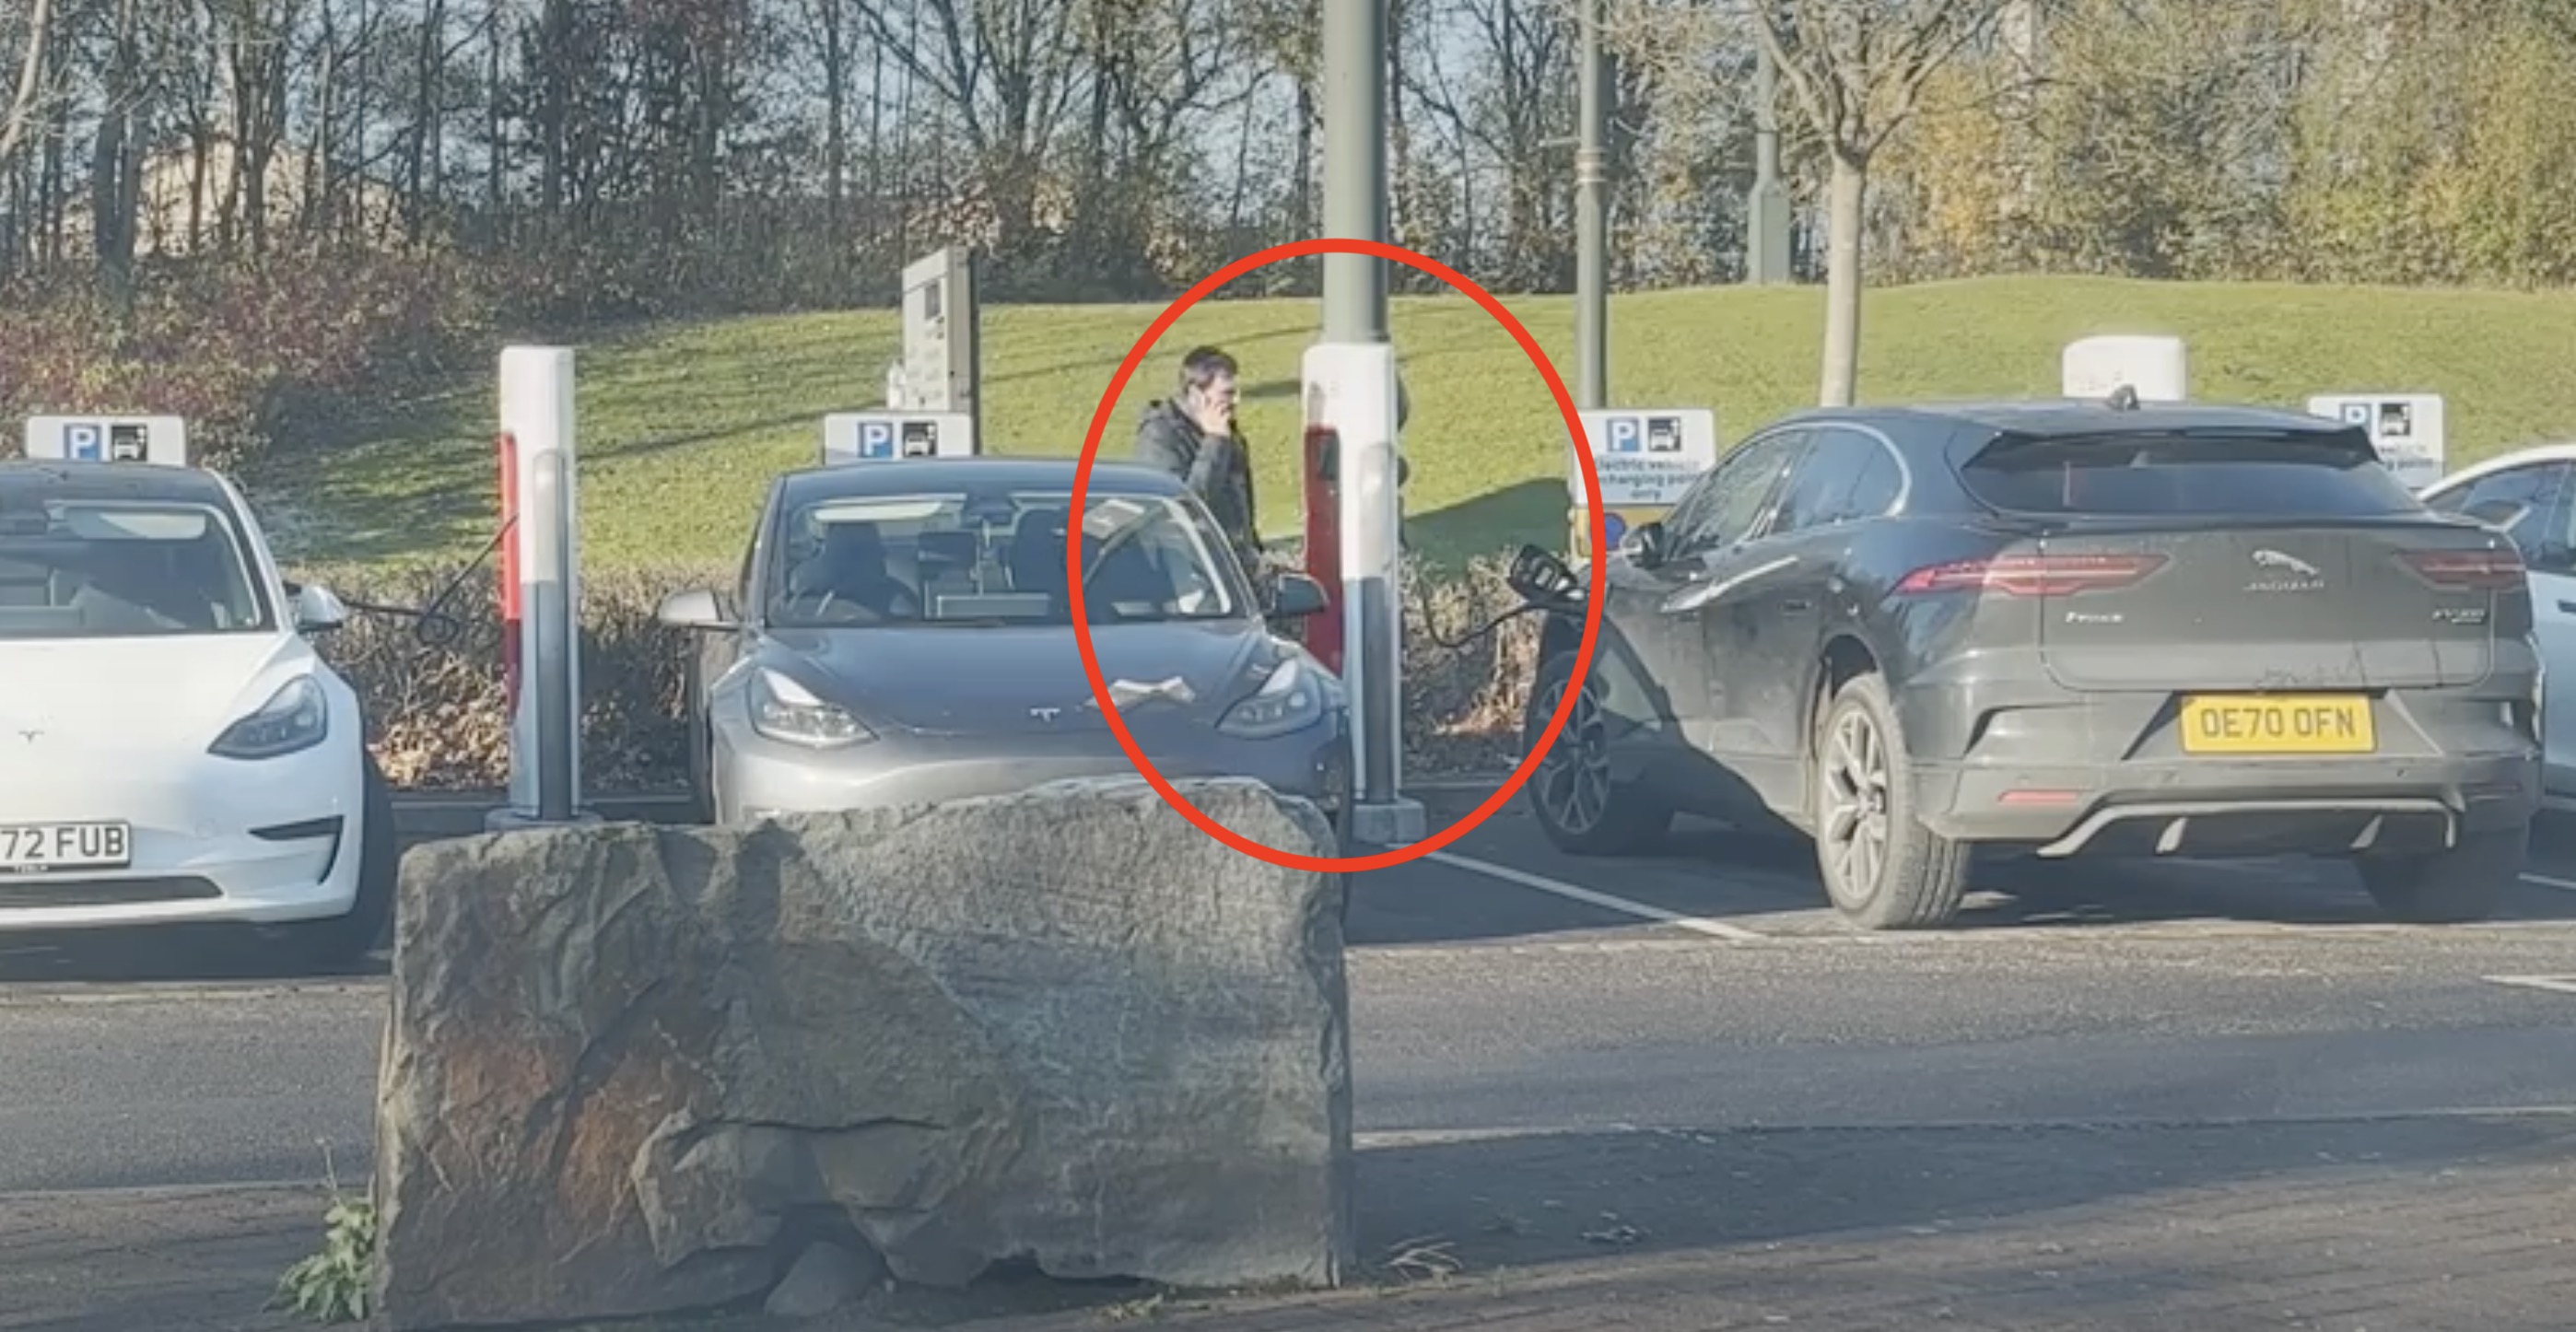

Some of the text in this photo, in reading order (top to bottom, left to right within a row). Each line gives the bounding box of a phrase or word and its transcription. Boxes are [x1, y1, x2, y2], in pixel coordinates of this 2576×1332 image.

[864, 424, 889, 458] P
[1612, 421, 1636, 450] P
[2200, 707, 2356, 738] OE70 OFN
[1, 826, 124, 859] 72 FUB
